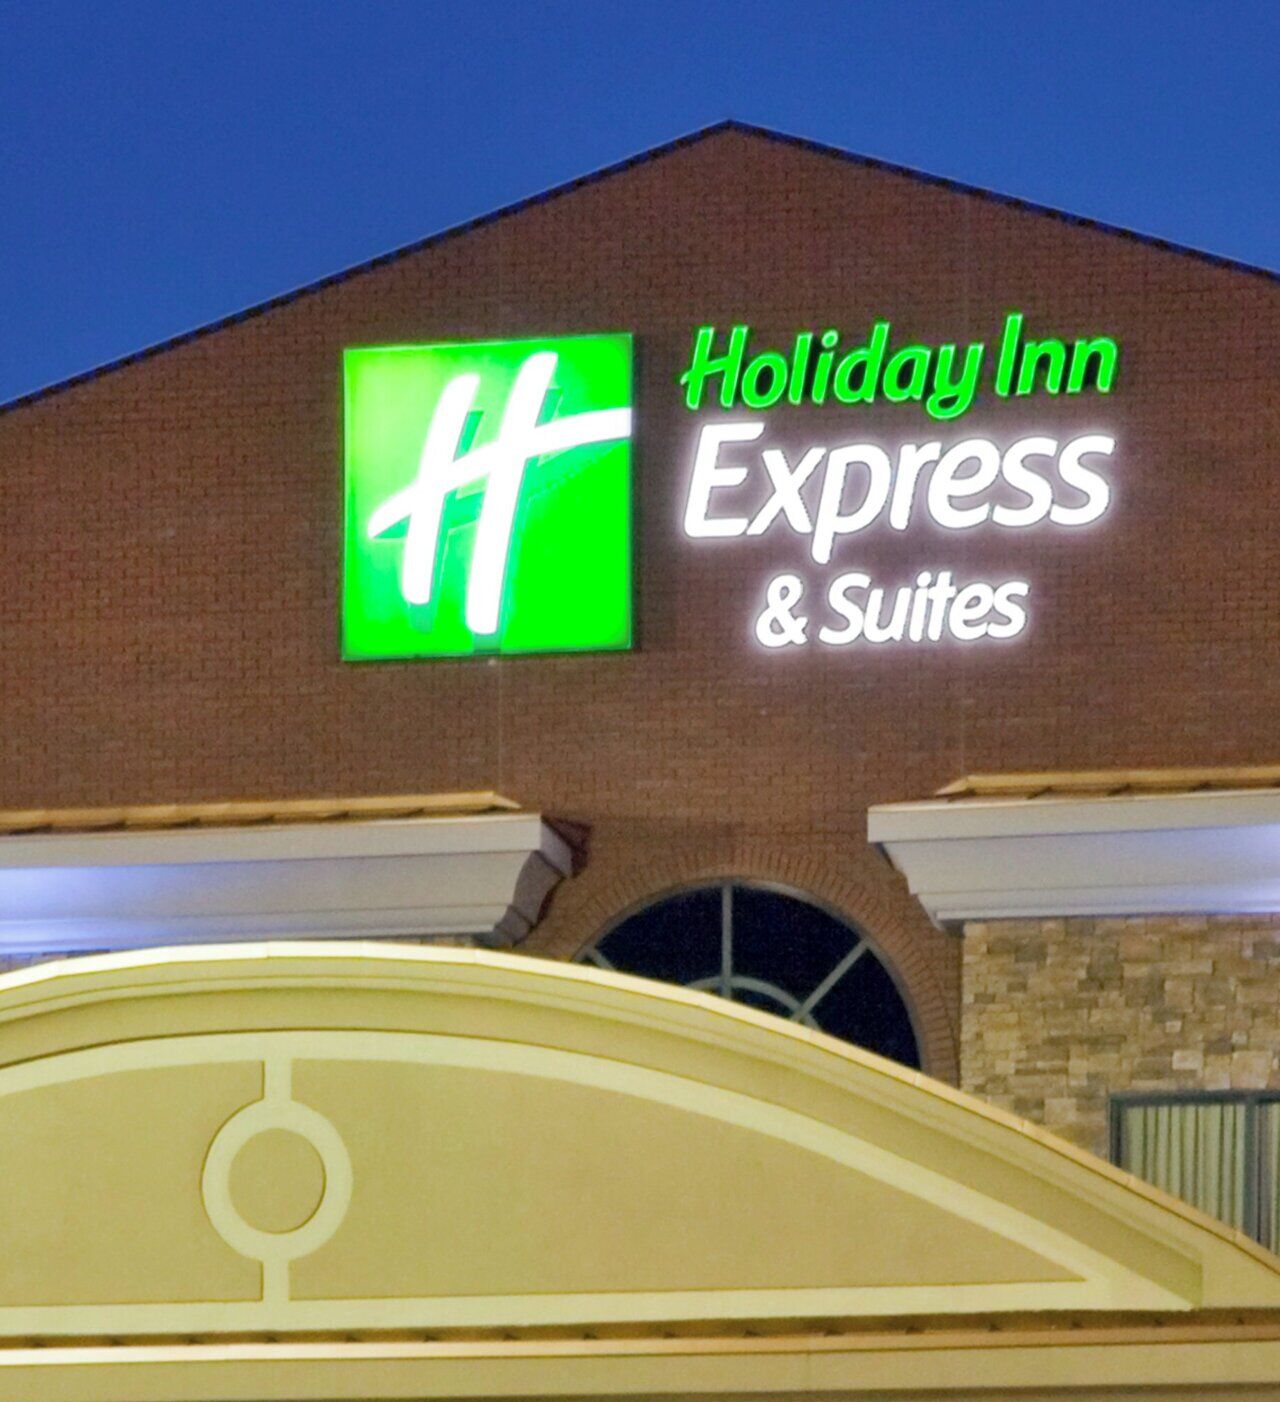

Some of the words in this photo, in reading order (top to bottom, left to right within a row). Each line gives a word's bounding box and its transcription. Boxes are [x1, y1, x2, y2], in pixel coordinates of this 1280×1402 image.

[679, 322, 984, 419] Holiday
[995, 313, 1117, 397] Inn
[682, 421, 1116, 564] Express
[754, 576, 808, 648] &
[819, 570, 1029, 644] Suites
